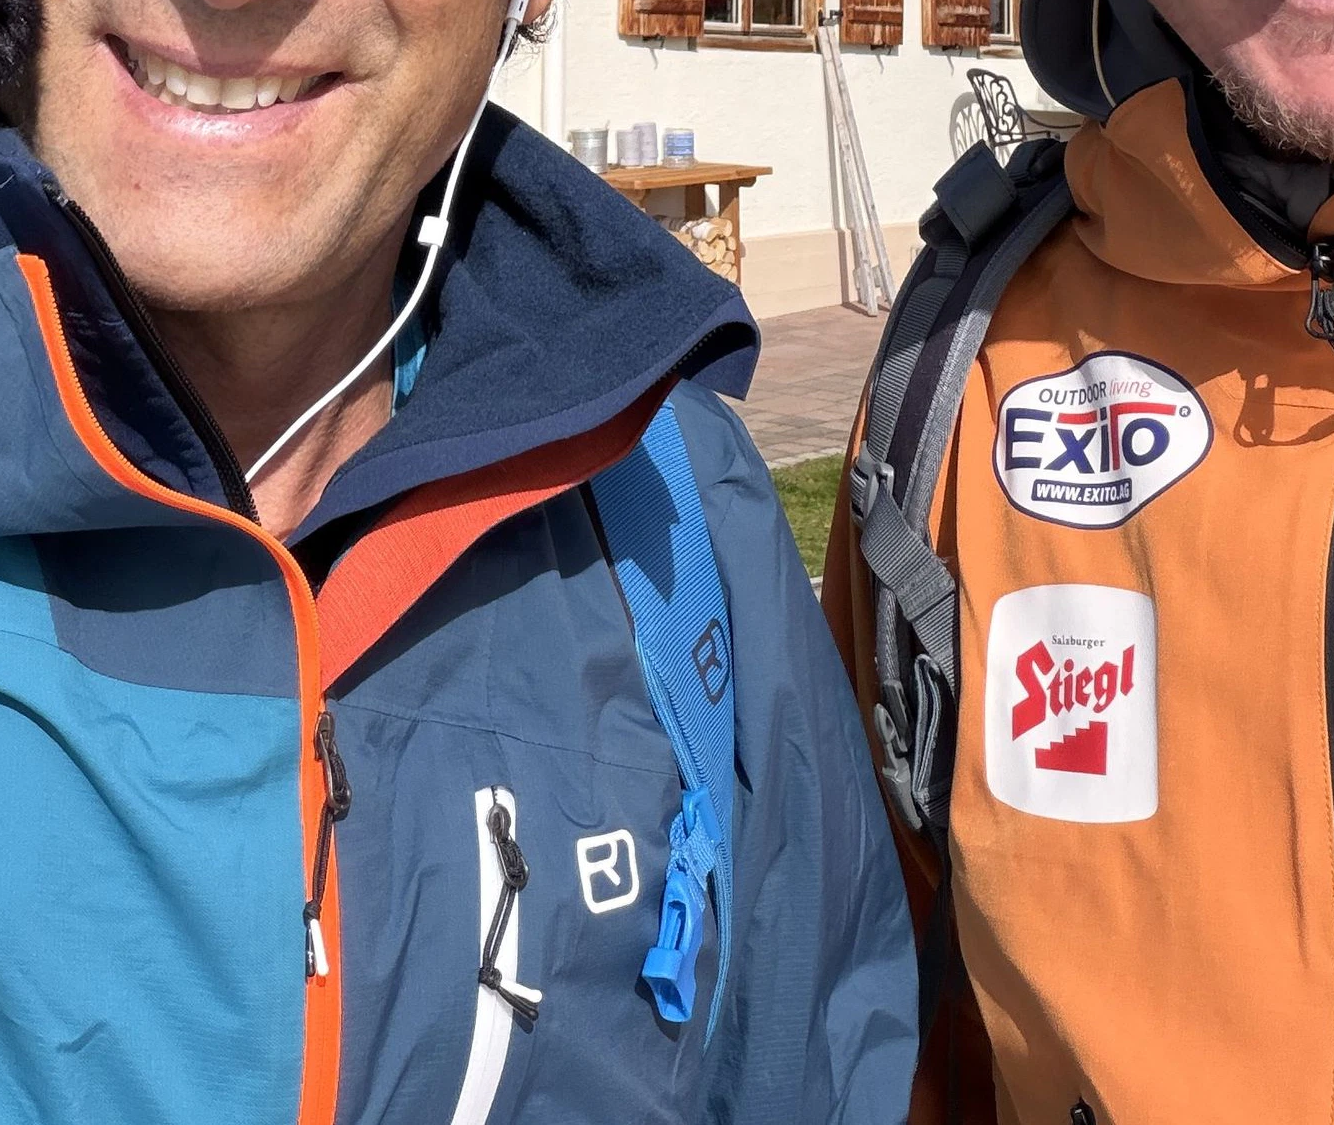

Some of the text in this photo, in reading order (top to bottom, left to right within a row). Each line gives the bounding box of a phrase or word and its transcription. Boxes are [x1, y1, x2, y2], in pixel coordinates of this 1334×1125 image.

[1038, 378, 1154, 405] OUTDOOR living
[1035, 482, 1130, 503] WWW.EXITO.AG
[1051, 634, 1106, 649] Salzburger
[1012, 640, 1135, 741] Stiegl
